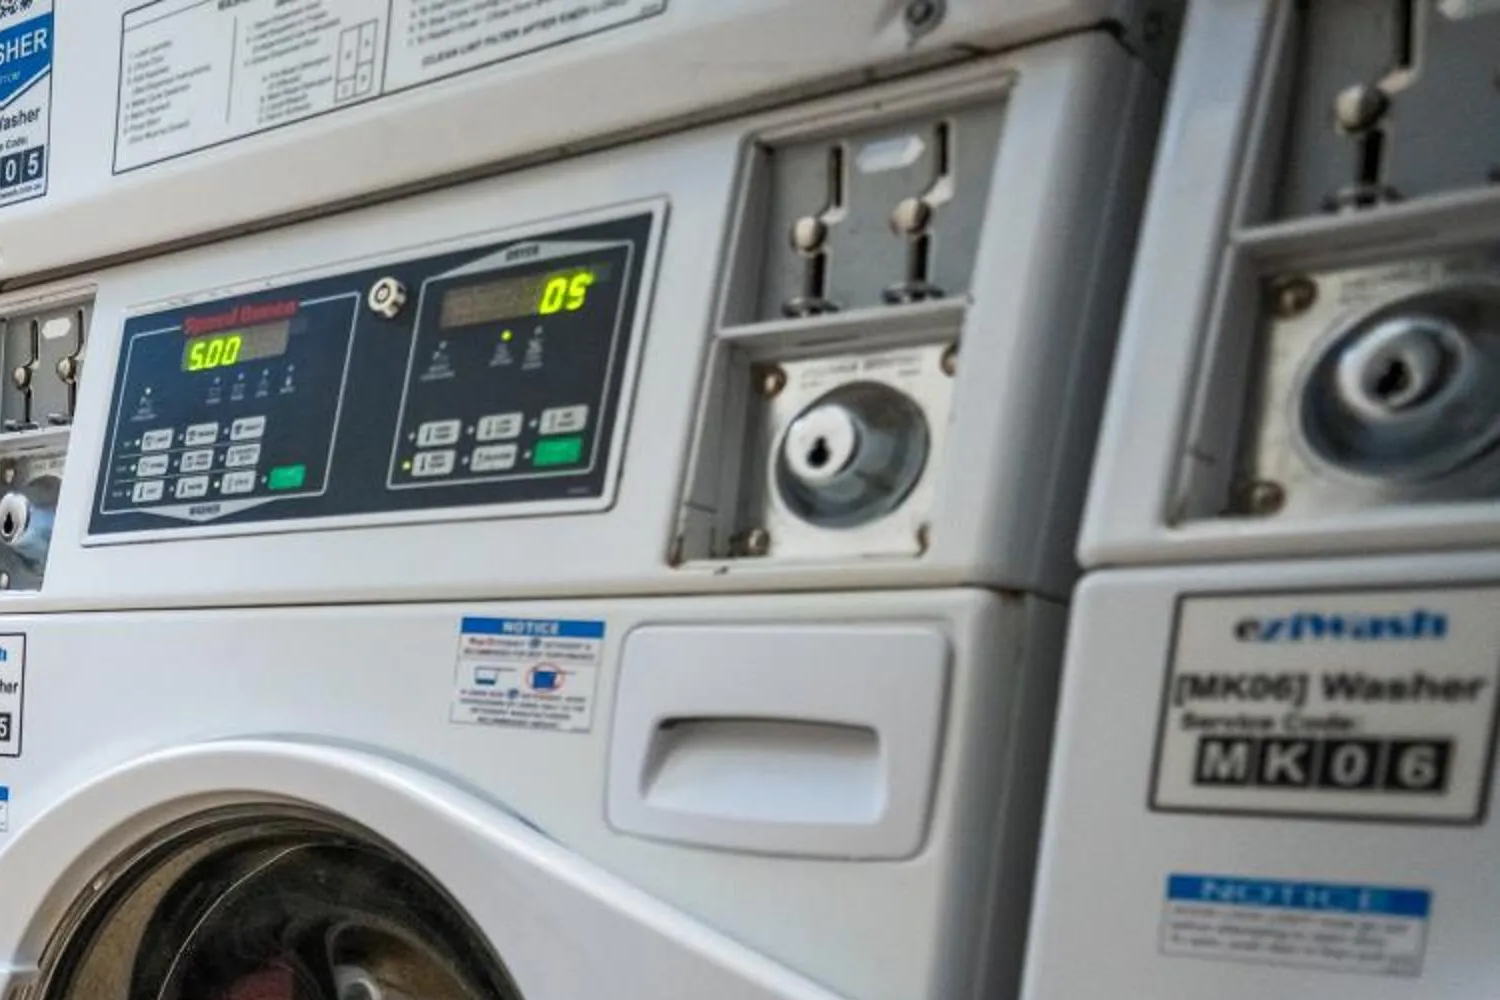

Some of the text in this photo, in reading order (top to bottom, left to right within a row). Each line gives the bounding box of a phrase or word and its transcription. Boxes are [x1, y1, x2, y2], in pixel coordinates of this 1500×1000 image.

[1234, 609, 1449, 642] eziWash
[1322, 669, 1489, 703] Washer
[1201, 739, 1438, 788] MK06
